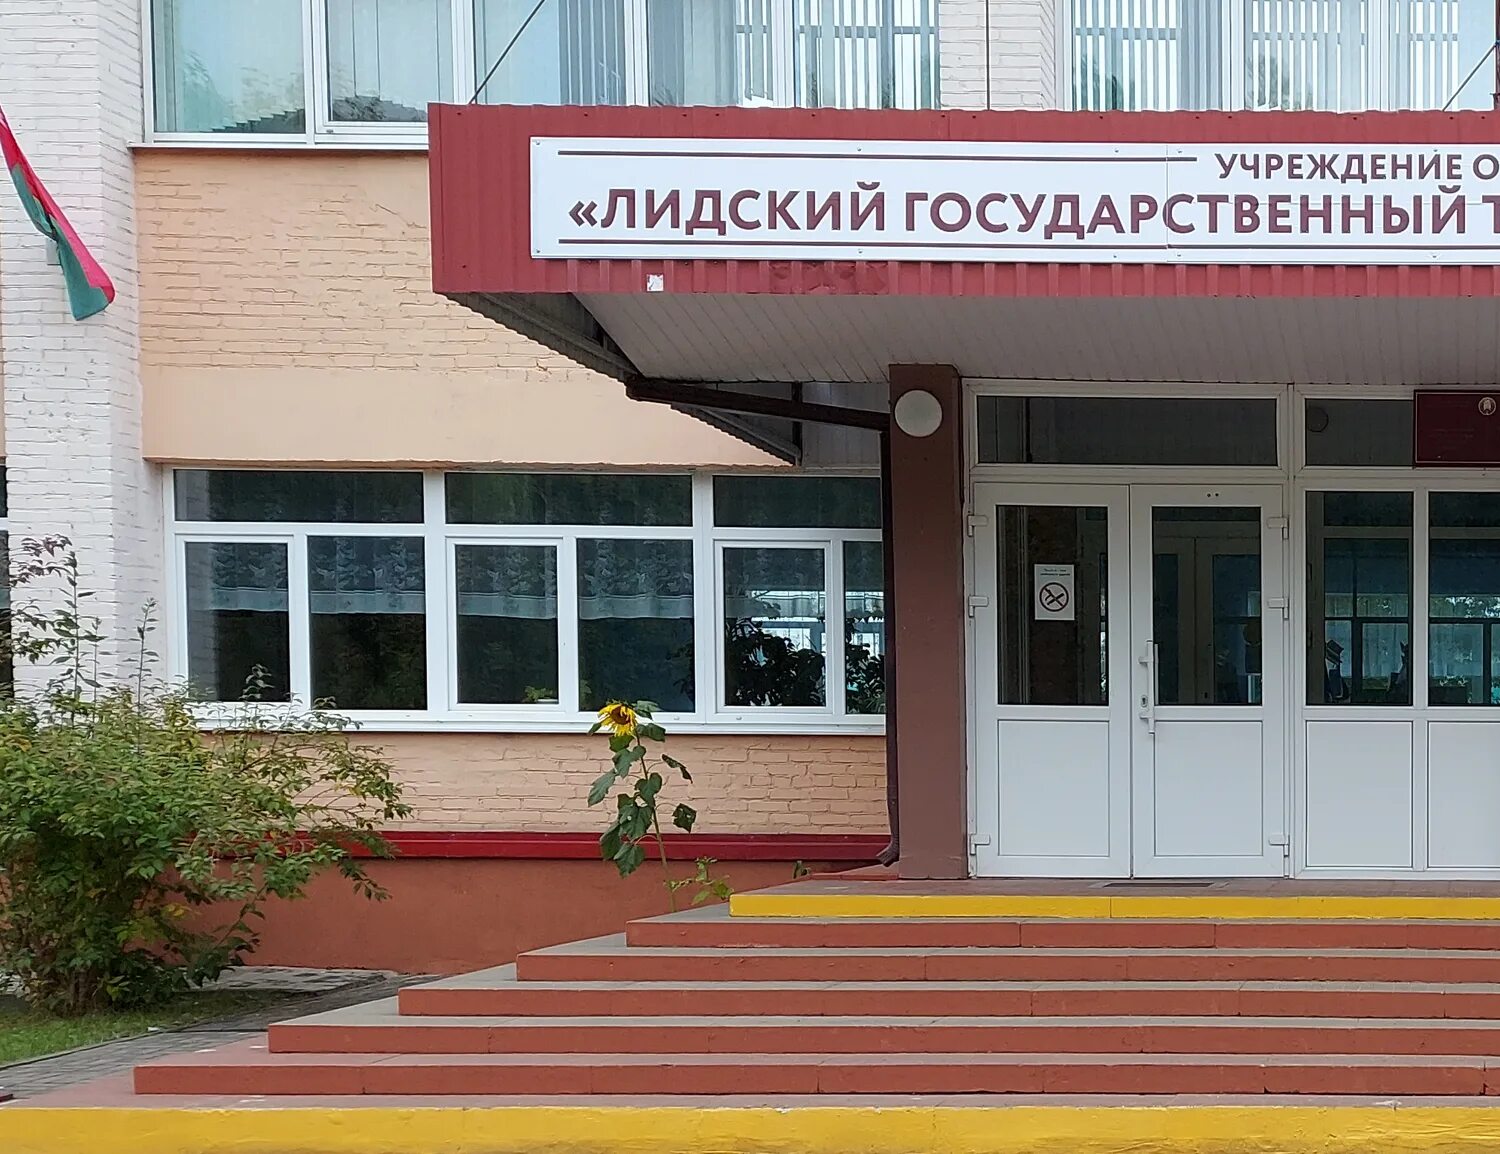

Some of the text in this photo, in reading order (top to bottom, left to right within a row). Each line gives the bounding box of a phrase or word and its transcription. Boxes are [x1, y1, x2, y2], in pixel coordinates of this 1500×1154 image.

[1215, 153, 1463, 184] УЧРЕЖДЕНИЕ
[568, 182, 885, 237] «ЛИДСКИЙ
[905, 184, 1466, 241] ГОСУДАРСТВЕННЫЙ
